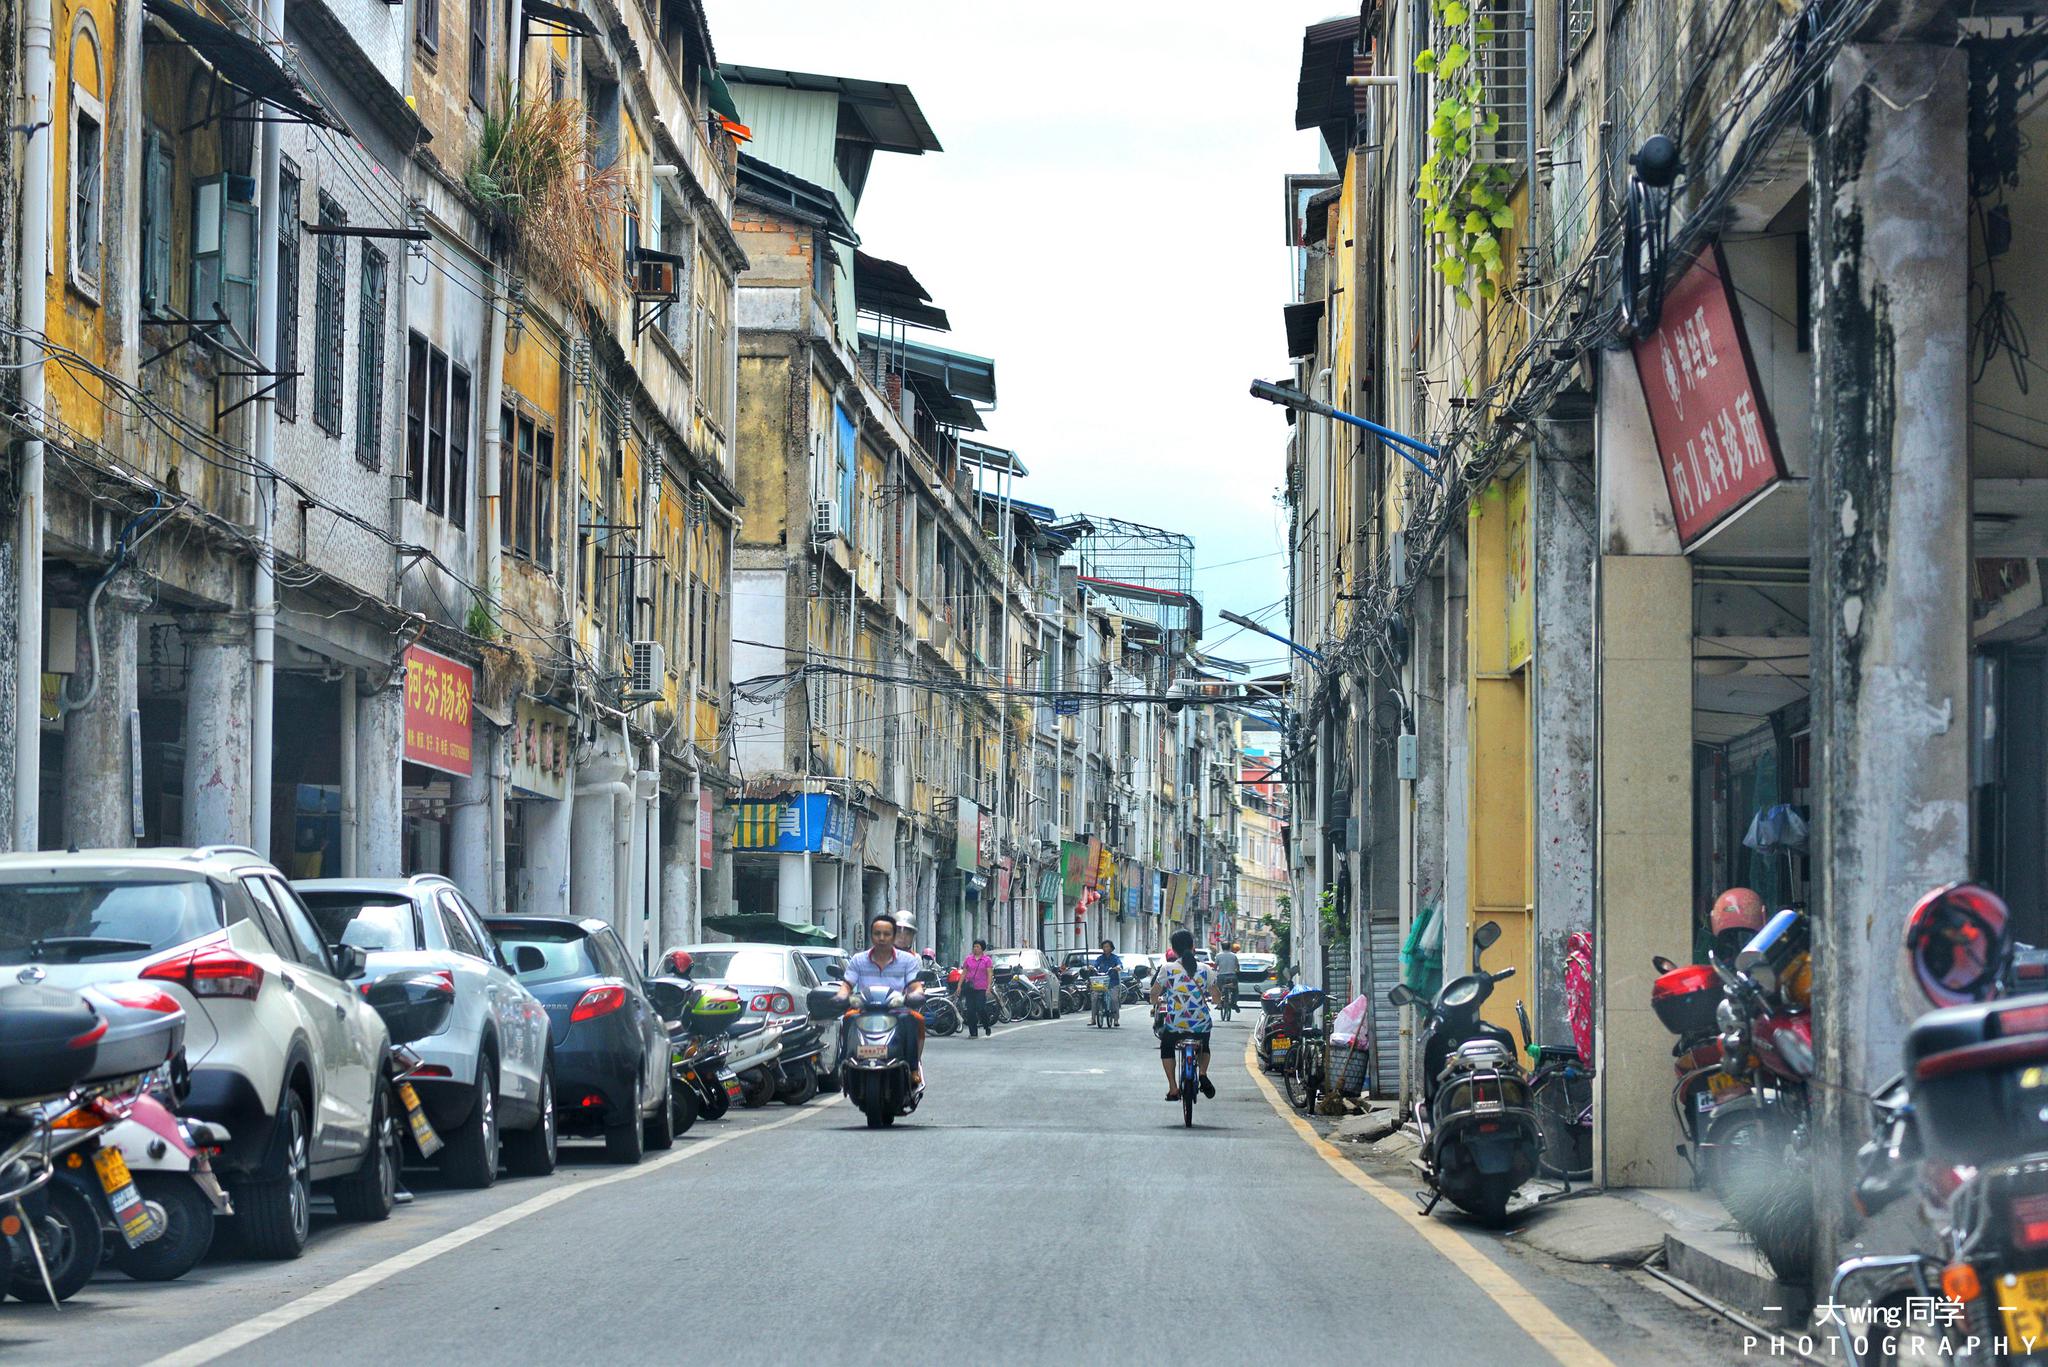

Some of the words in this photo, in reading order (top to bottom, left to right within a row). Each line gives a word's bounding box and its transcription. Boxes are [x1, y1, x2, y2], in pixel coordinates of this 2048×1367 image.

[1673, 391, 1766, 522] 内儿科诊所
[407, 657, 470, 728] 阿芬肠粉
